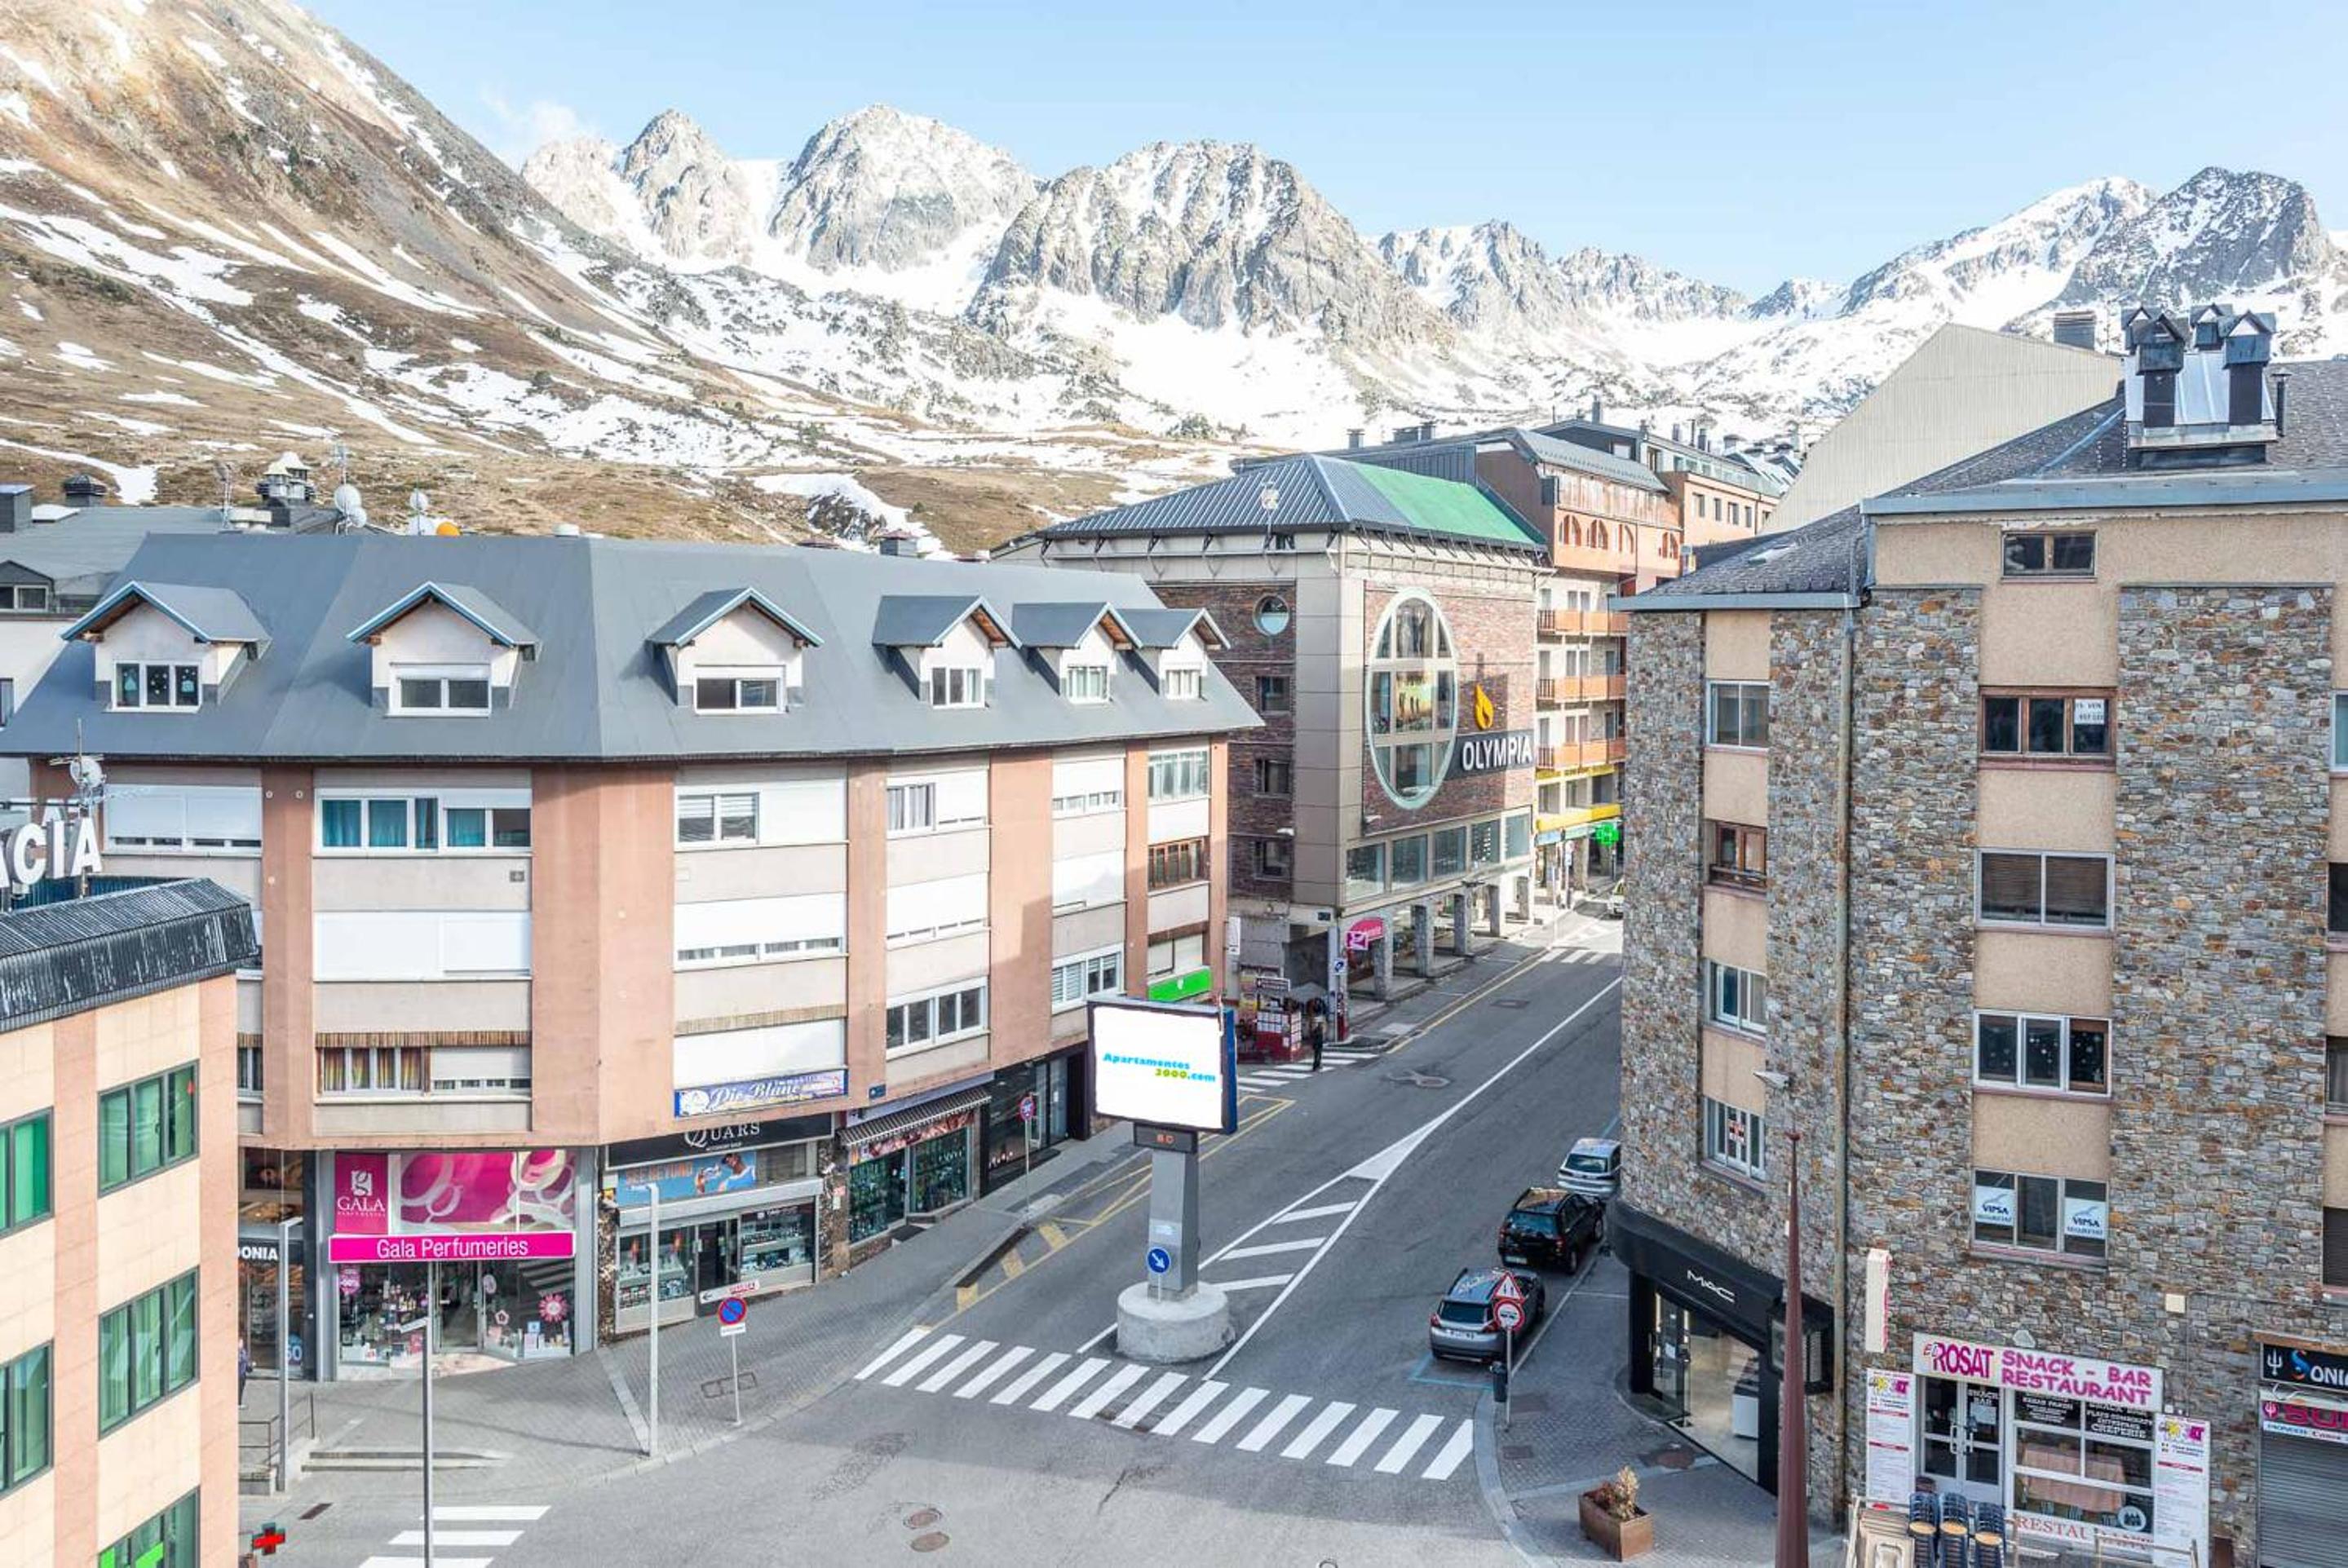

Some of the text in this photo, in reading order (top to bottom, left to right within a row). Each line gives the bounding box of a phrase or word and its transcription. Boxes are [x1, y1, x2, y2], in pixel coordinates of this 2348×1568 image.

[1462, 735, 1533, 771] OLYMPIA
[684, 1123, 761, 1148] QUARS
[337, 1195, 386, 1212] GALA
[237, 1245, 278, 1261] ONIA
[376, 1237, 529, 1259] Gala Perfumeries
[1932, 1342, 1995, 1379] ROSAT
[2001, 1349, 2074, 1376] SNACK
[2107, 1365, 2152, 1388] BAR
[2001, 1367, 2152, 1407] RESTAURANT
